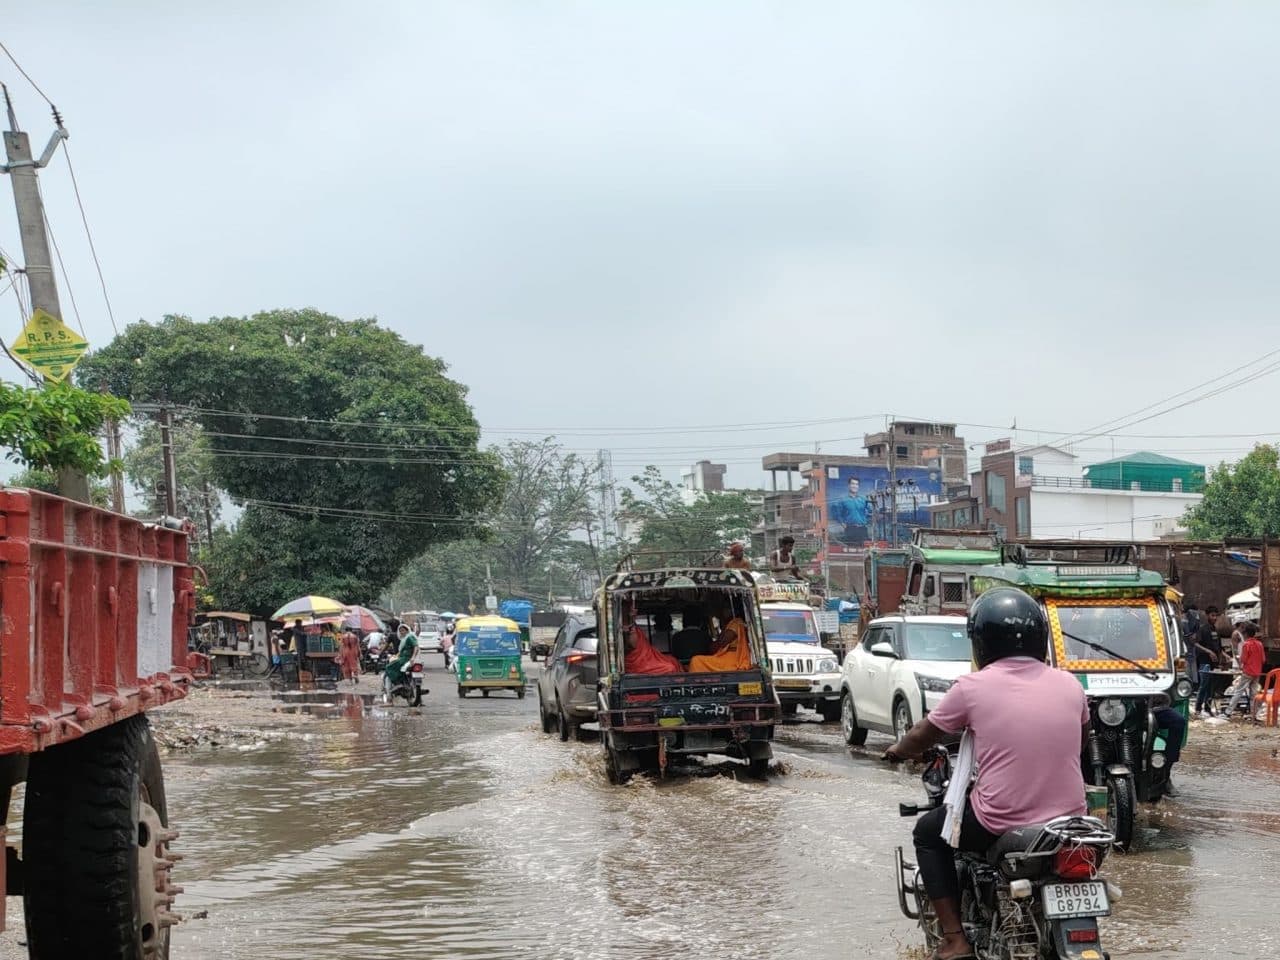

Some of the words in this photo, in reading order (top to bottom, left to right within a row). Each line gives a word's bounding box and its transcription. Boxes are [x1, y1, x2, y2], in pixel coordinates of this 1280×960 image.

[643, 570, 718, 583] WELCOME
[1055, 883, 1098, 898] BR06D
[1057, 898, 1100, 912] G8794
